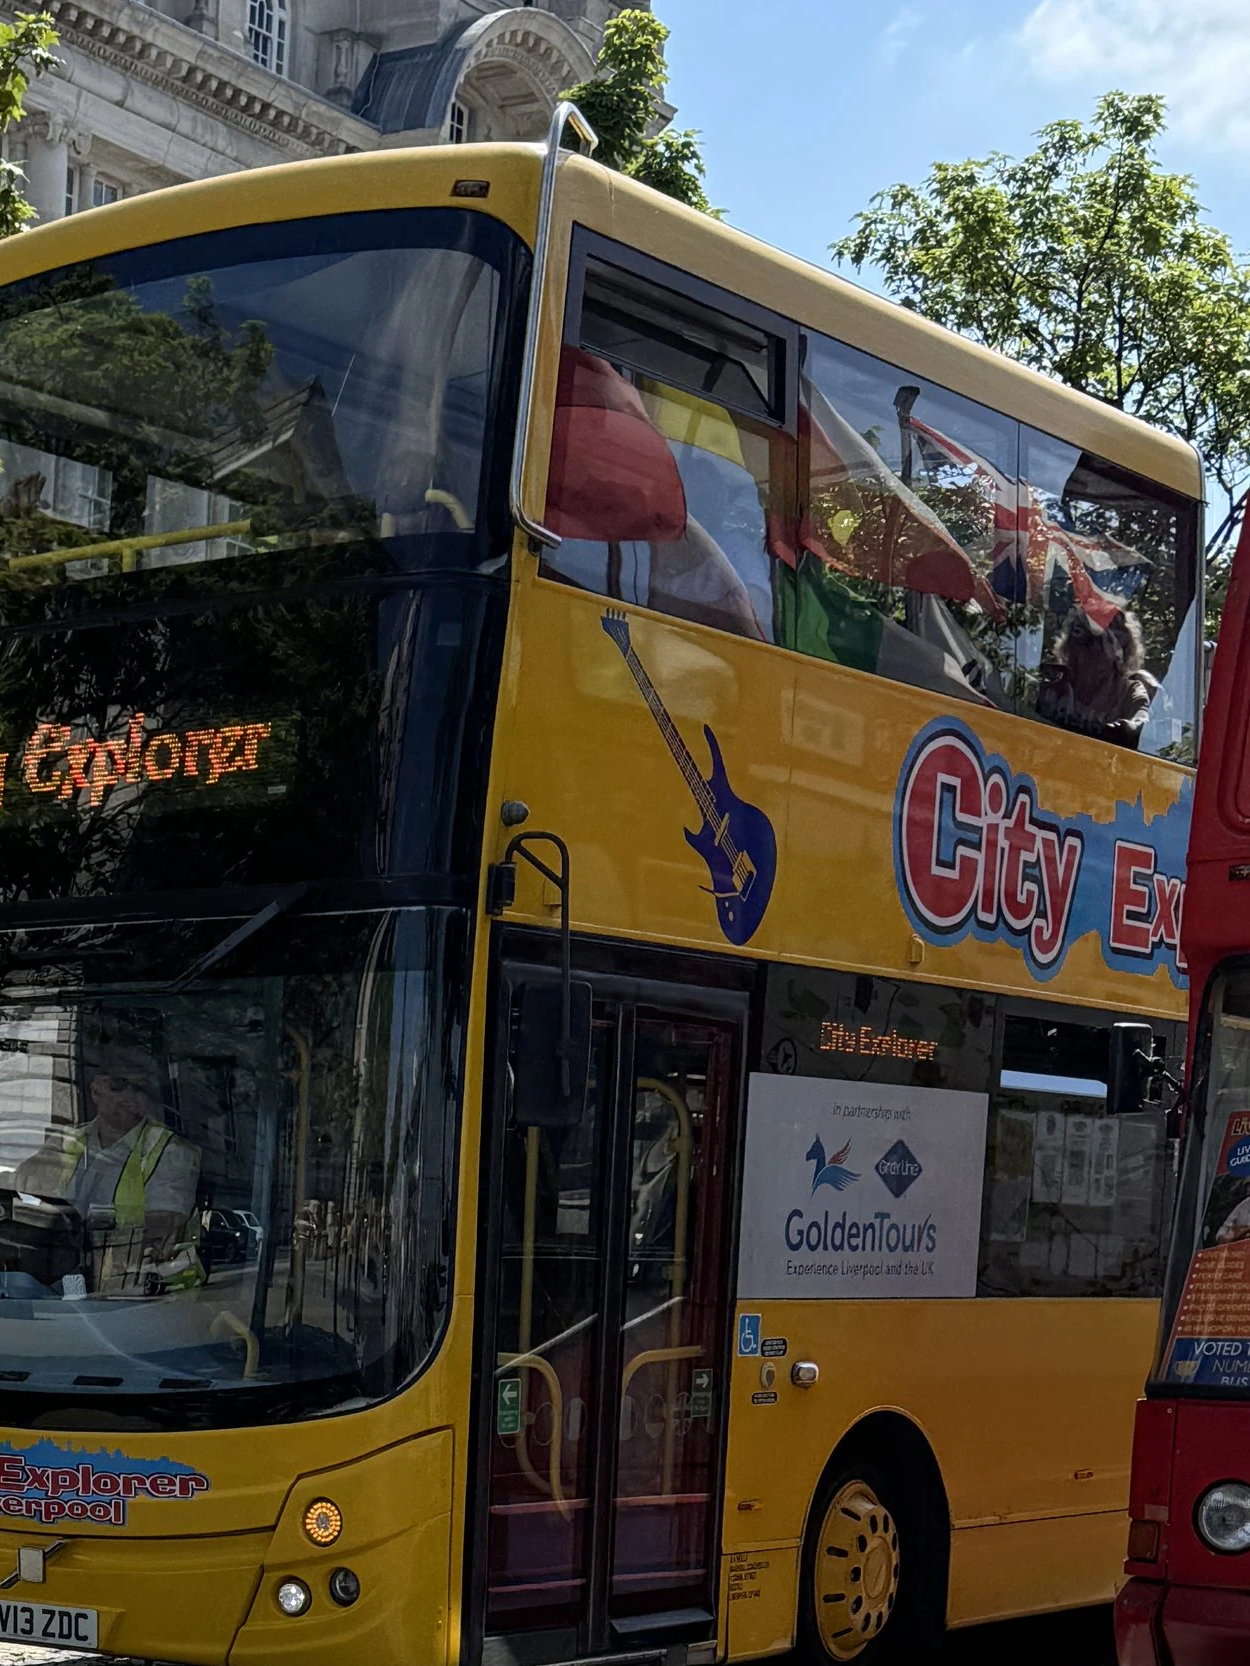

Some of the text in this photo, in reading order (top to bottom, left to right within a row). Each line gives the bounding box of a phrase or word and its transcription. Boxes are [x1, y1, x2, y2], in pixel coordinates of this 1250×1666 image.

[24, 712, 271, 807] Explorer
[902, 735, 1082, 964] City
[785, 1208, 937, 1253] GoldenTours
[786, 1260, 934, 1279] Experience Liverpool and the UK
[1194, 1341, 1242, 1356] VOTED
[42, 1609, 89, 1641] ZDC
